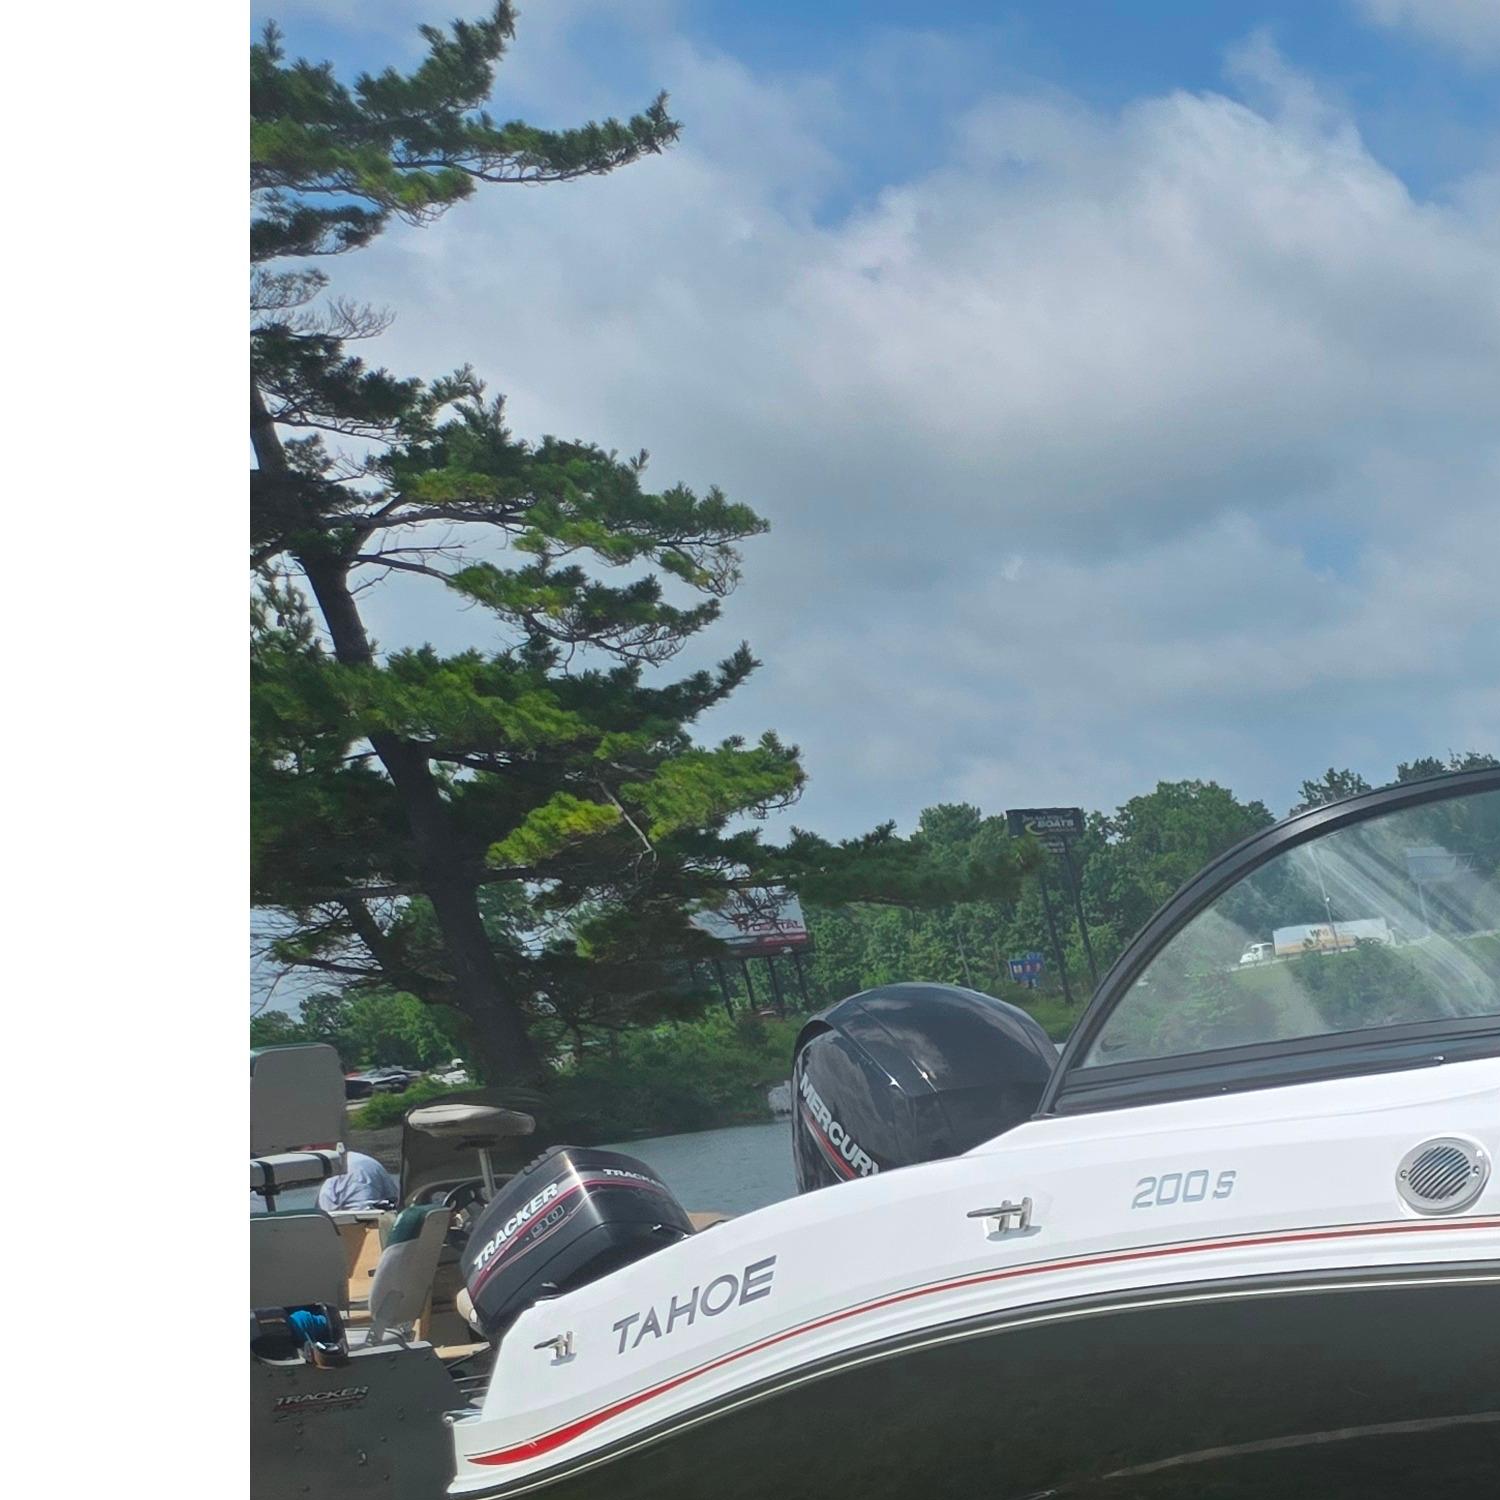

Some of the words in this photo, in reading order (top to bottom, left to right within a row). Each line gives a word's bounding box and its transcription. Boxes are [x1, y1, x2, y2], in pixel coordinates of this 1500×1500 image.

[474, 1183, 558, 1270] TRACKER
[1131, 1169, 1209, 1209] 200
[613, 1255, 777, 1354] TAHOE
